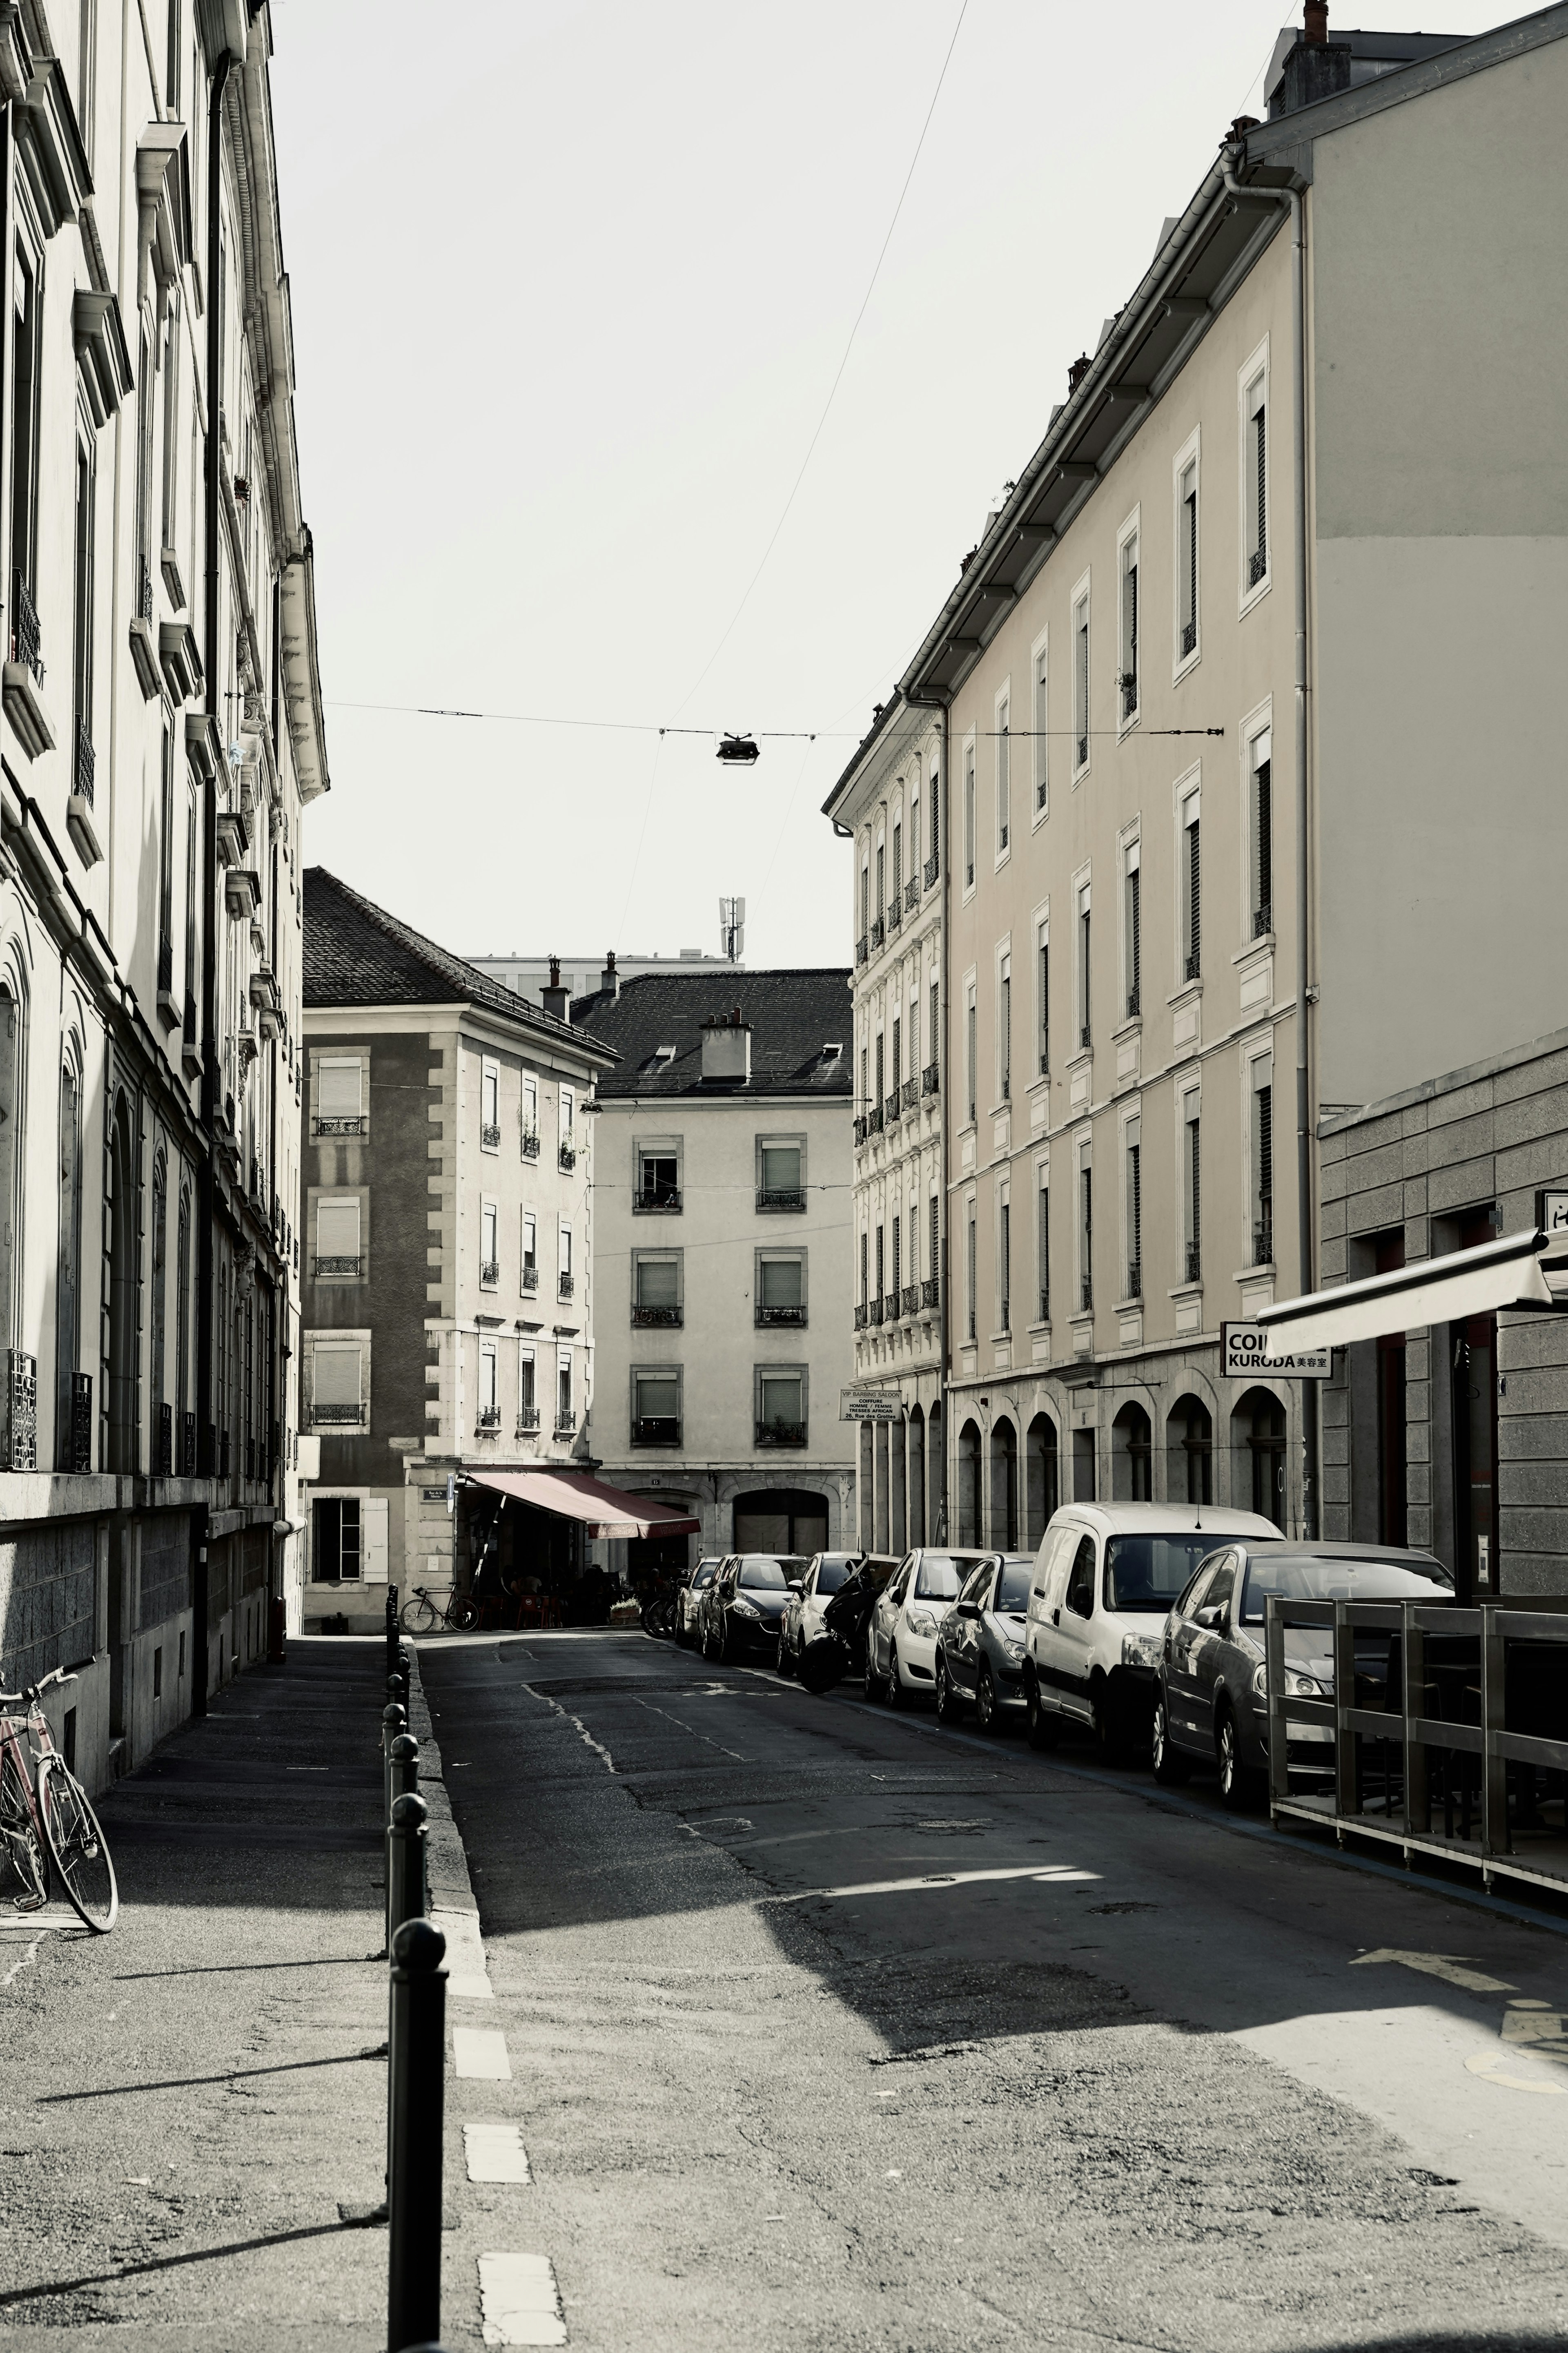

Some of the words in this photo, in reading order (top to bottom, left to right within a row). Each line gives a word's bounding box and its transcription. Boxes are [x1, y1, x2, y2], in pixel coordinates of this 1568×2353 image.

[1229, 1354, 1295, 1368] KURODA
[1297, 1357, 1327, 1367] 美容室
